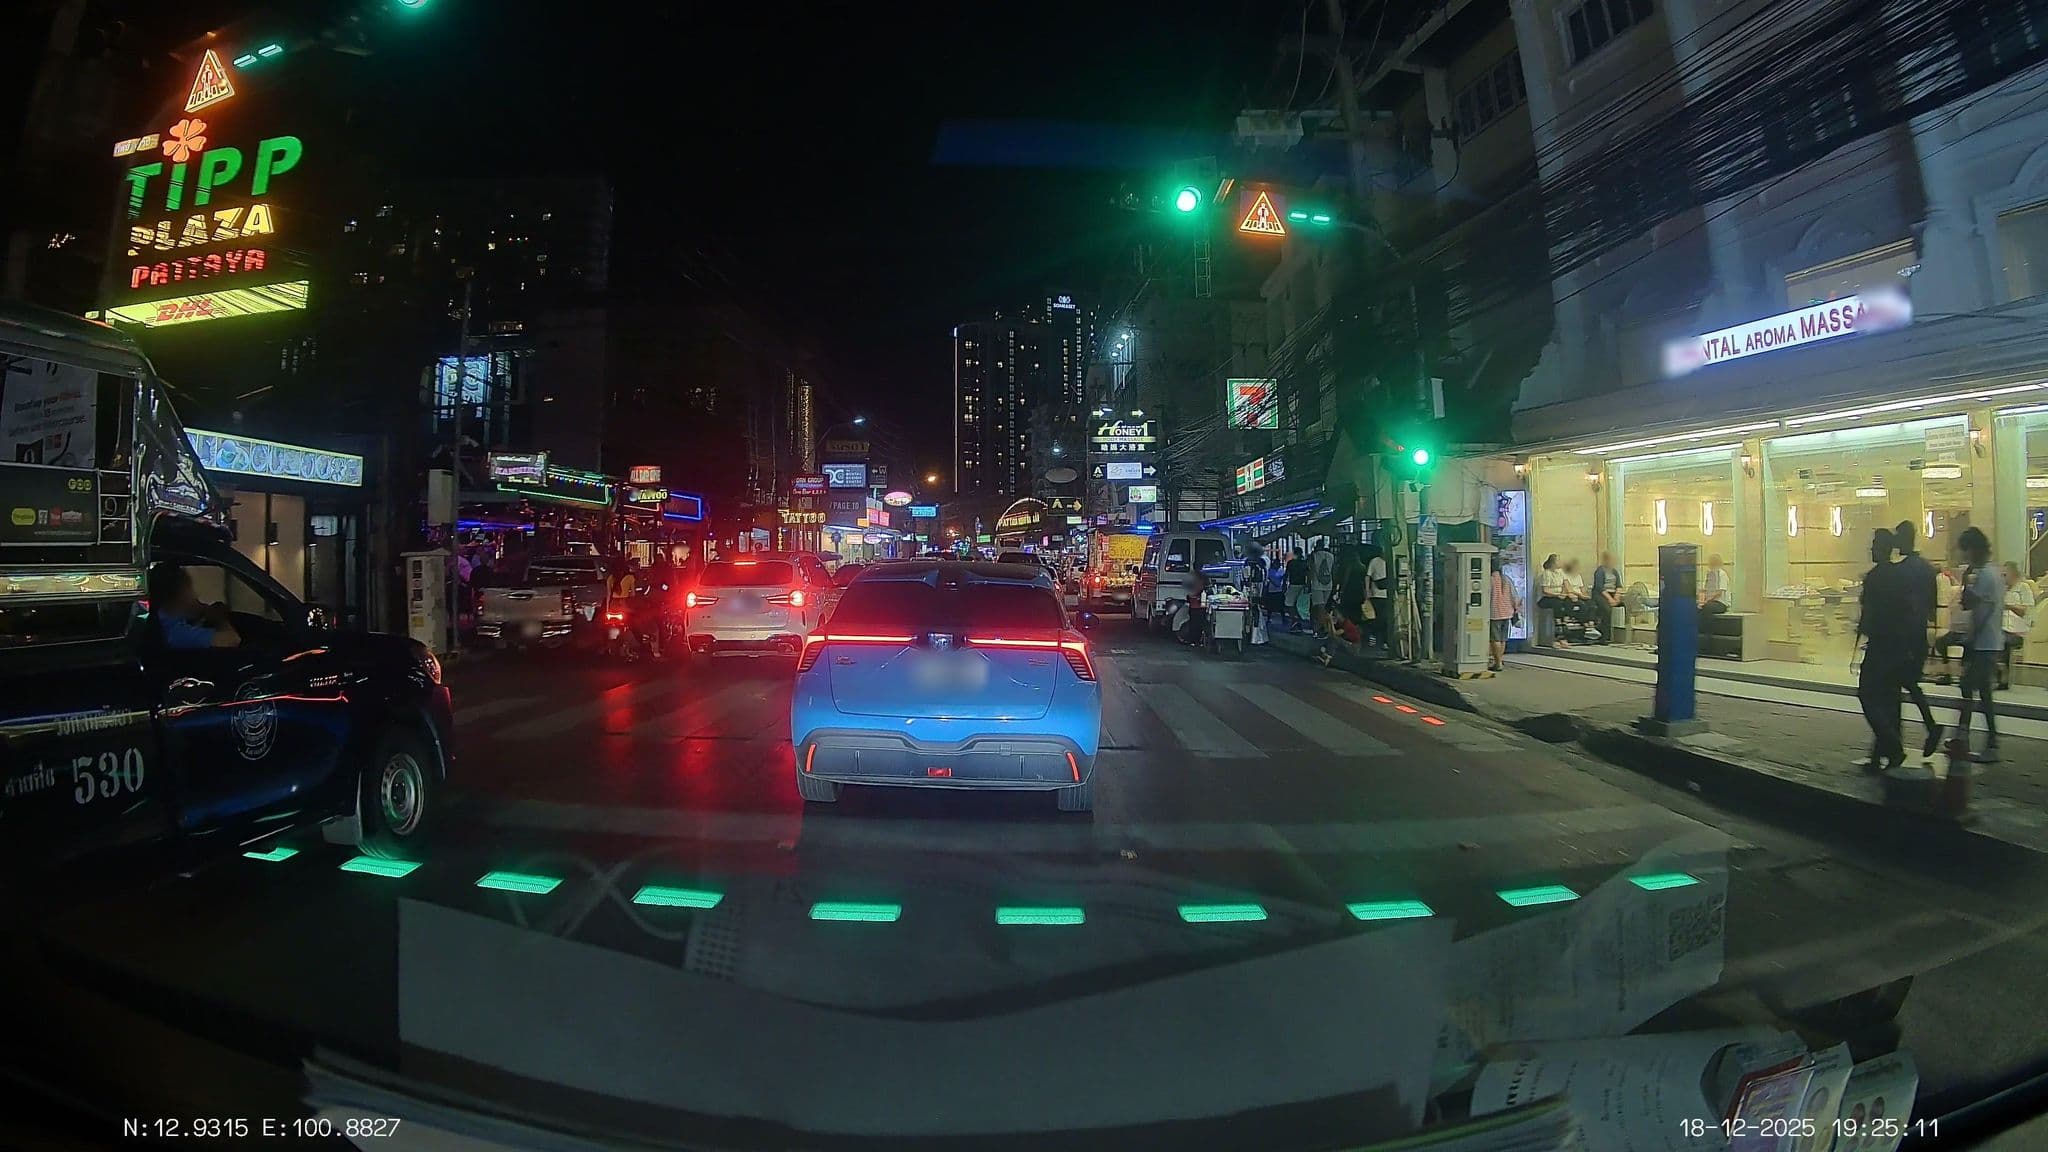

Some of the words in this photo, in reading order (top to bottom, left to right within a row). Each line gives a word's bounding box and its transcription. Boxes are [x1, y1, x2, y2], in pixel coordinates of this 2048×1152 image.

[127, 136, 303, 219] TIPP
[128, 202, 275, 257] PLAZA
[130, 248, 265, 289] PATTAYA
[156, 297, 217, 322] DHL
[1745, 323, 1796, 352] AROMA
[778, 509, 826, 524] TATTOO
[72, 747, 145, 804] 530
